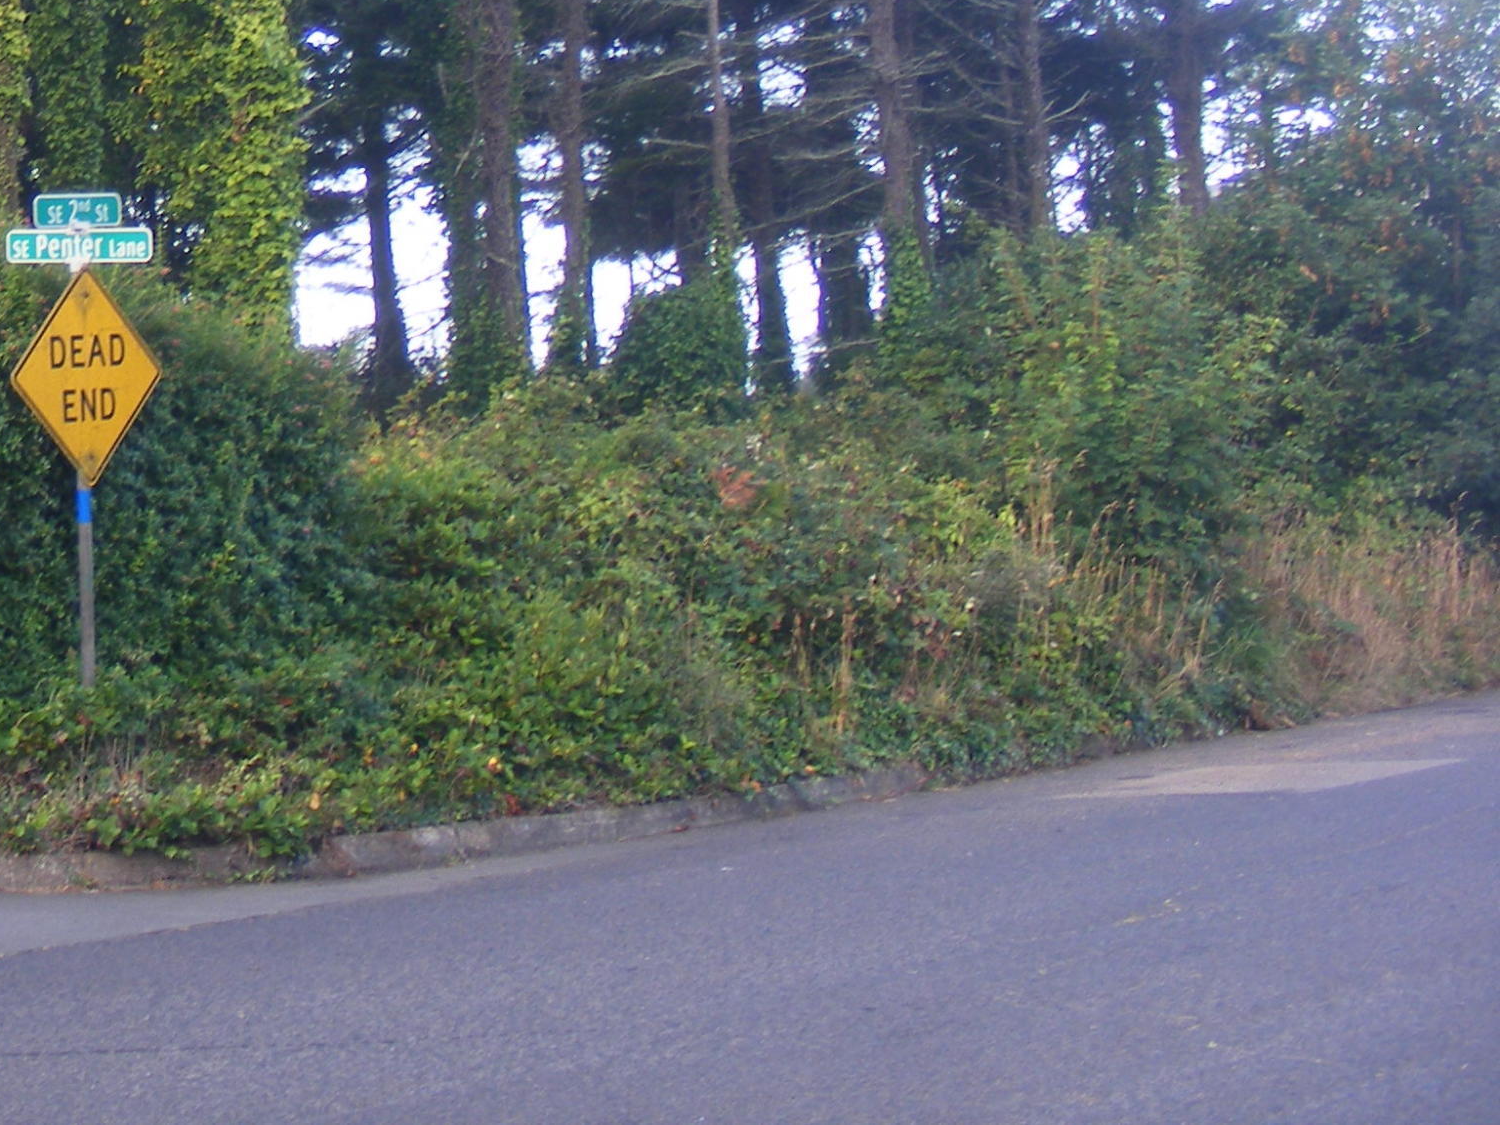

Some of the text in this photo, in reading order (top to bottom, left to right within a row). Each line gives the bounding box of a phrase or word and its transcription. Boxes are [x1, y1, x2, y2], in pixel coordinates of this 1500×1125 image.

[47, 198, 108, 224] SE 2nd St
[12, 234, 147, 259] SE Penter Lane
[49, 333, 125, 369] DEAD
[62, 387, 116, 423] END
